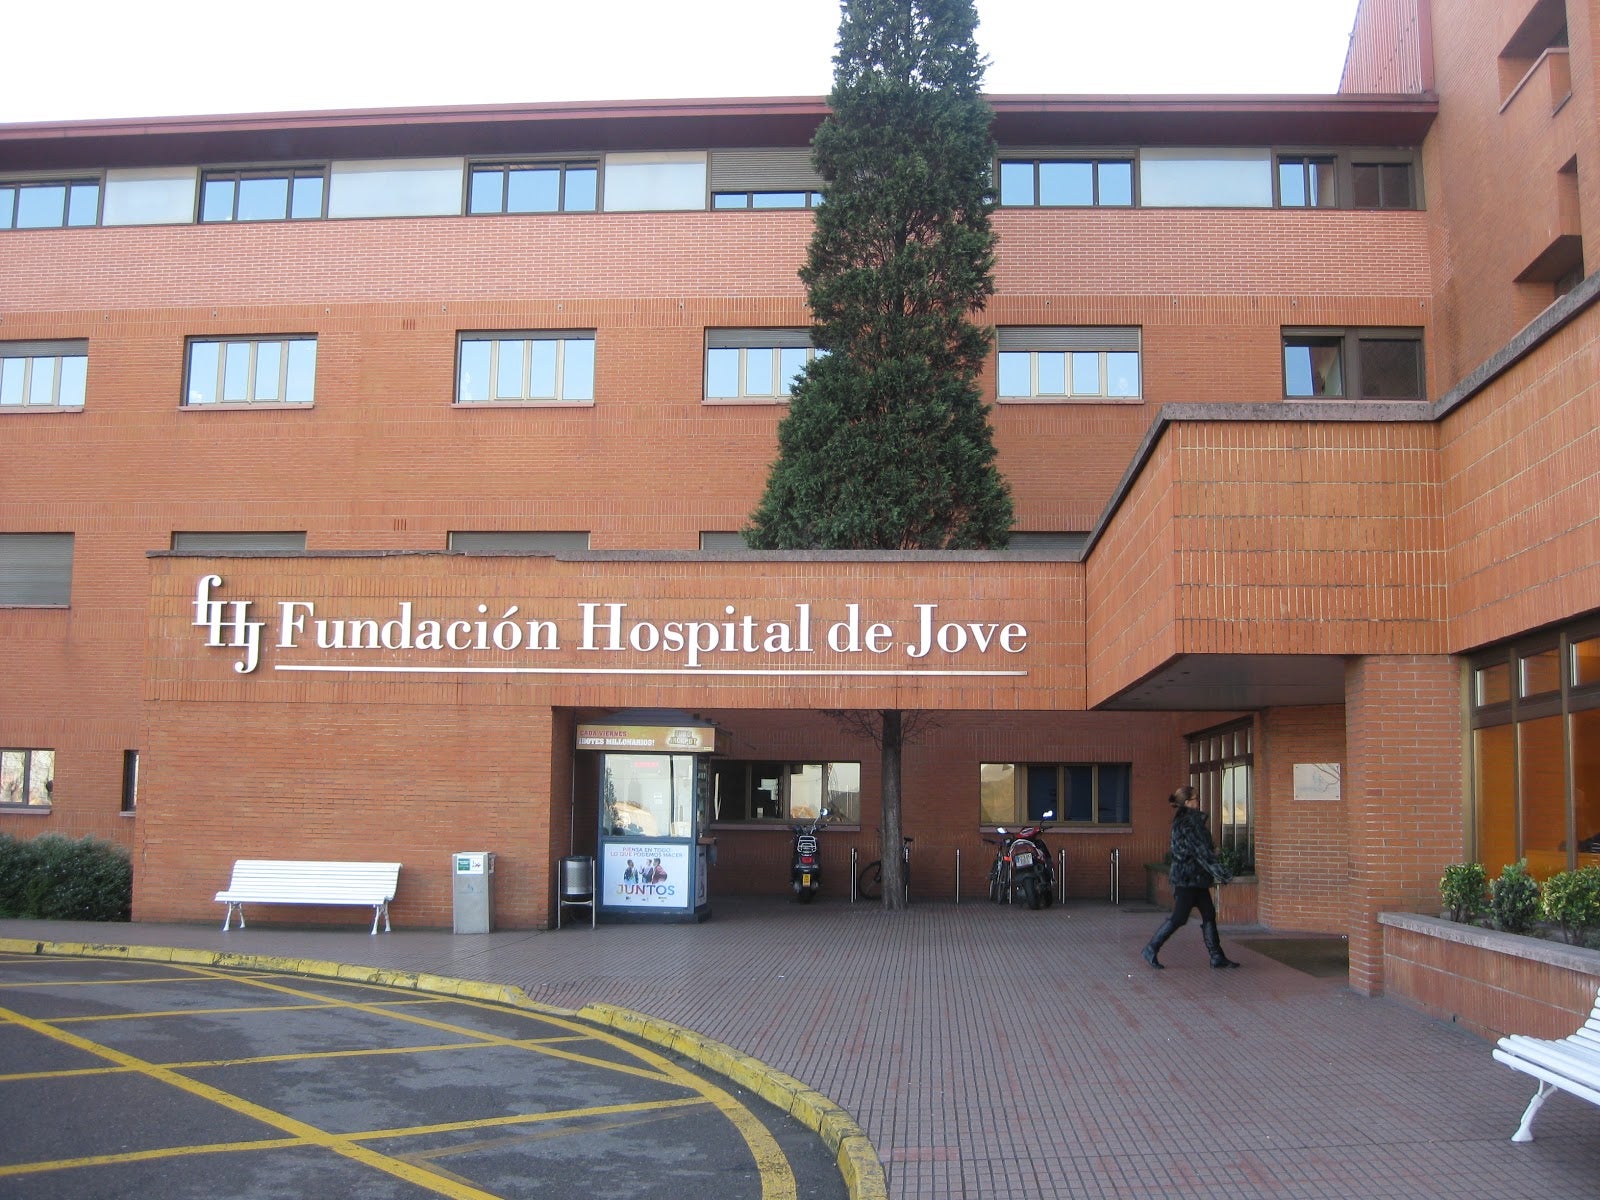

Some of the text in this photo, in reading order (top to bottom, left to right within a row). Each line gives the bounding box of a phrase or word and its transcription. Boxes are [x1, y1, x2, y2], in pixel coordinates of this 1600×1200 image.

[276, 602, 1027, 667] Fundación Hospital de Jove
[605, 738, 655, 746] MILLONARIOS!
[616, 884, 675, 895] JUNTOS
